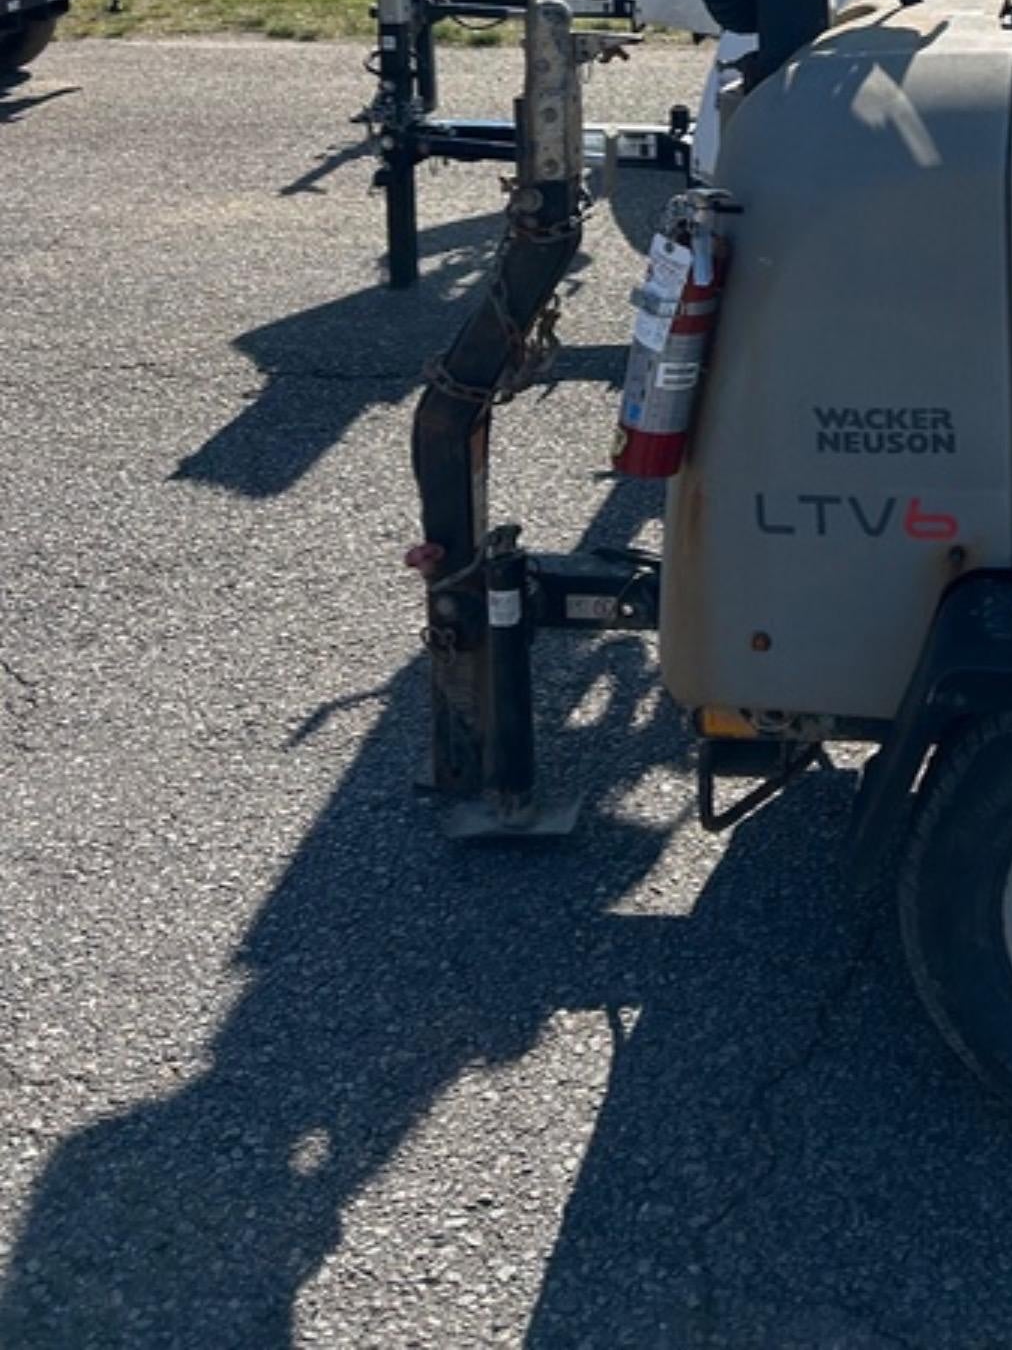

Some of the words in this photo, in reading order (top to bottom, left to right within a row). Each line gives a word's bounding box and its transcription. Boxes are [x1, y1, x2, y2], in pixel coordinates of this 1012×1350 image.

[814, 407, 954, 430] WACKER
[816, 432, 955, 454] NEUSON
[755, 493, 959, 540] LTV6
